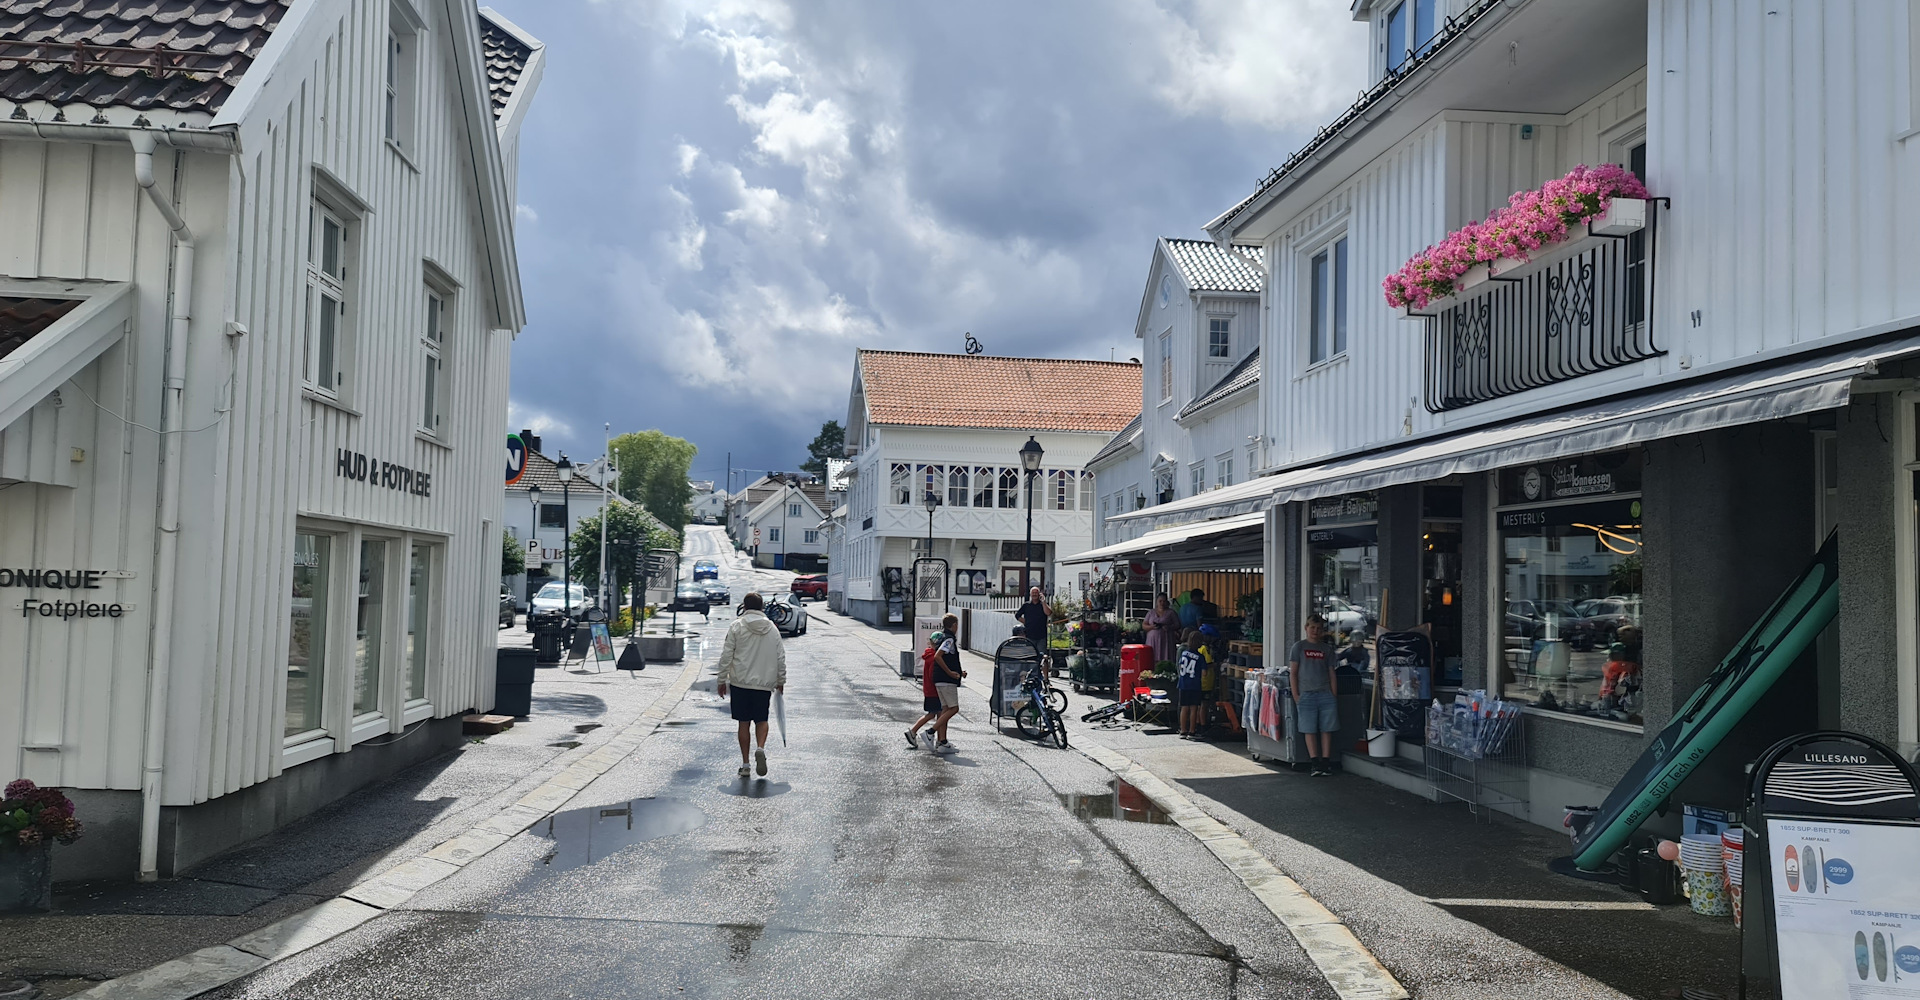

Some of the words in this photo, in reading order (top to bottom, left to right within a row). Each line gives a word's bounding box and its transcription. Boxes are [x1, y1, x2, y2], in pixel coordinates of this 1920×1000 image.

[337, 448, 367, 482] HUD
[370, 458, 379, 486] &
[382, 461, 431, 497] FOTPLEIE
[1346, 498, 1378, 515] Belysnin
[529, 541, 538, 552] P
[541, 548, 562, 560] UB
[922, 565, 936, 573] Son
[23, 599, 123, 621] Fotpleie
[921, 622, 944, 630] salatb
[1180, 656, 1197, 678] 34
[1804, 753, 1867, 764] LILLESAND
[1624, 809, 1642, 826] 1852
[1652, 781, 1670, 799] SUP
[1667, 762, 1690, 781] Tech
[1797, 826, 1837, 834] SUP-BRETT
[1829, 866, 1847, 874] 2999
[1866, 911, 1908, 919] SUP-BRETT
[1871, 921, 1902, 929] KAMPANJE
